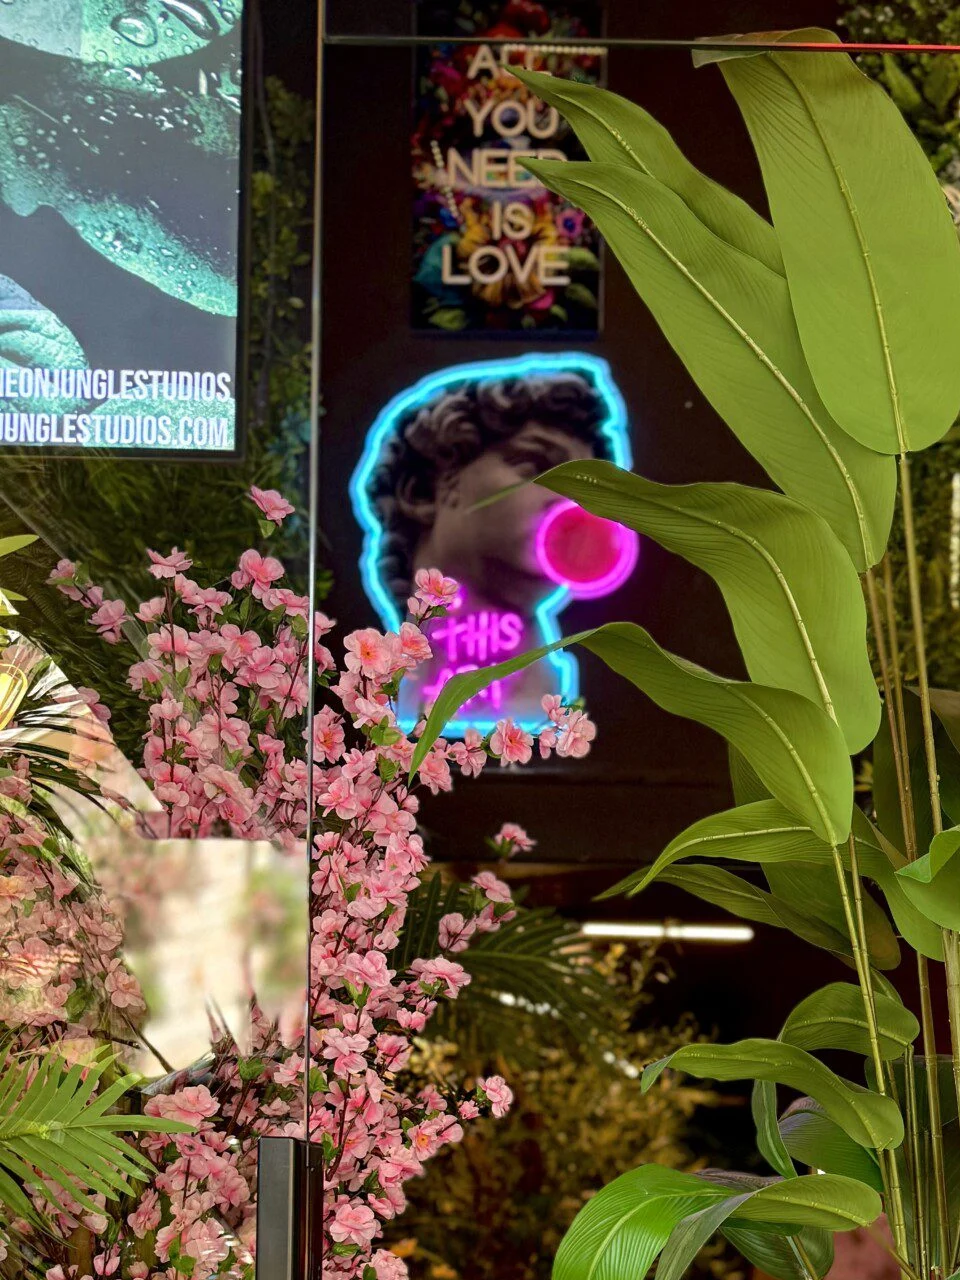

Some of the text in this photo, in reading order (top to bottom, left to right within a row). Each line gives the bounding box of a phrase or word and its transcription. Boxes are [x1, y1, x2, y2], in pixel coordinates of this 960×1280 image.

[464, 100, 558, 138] YOU
[492, 201, 534, 240] IS
[441, 245, 571, 285] LOVE
[431, 610, 524, 661] THIS
